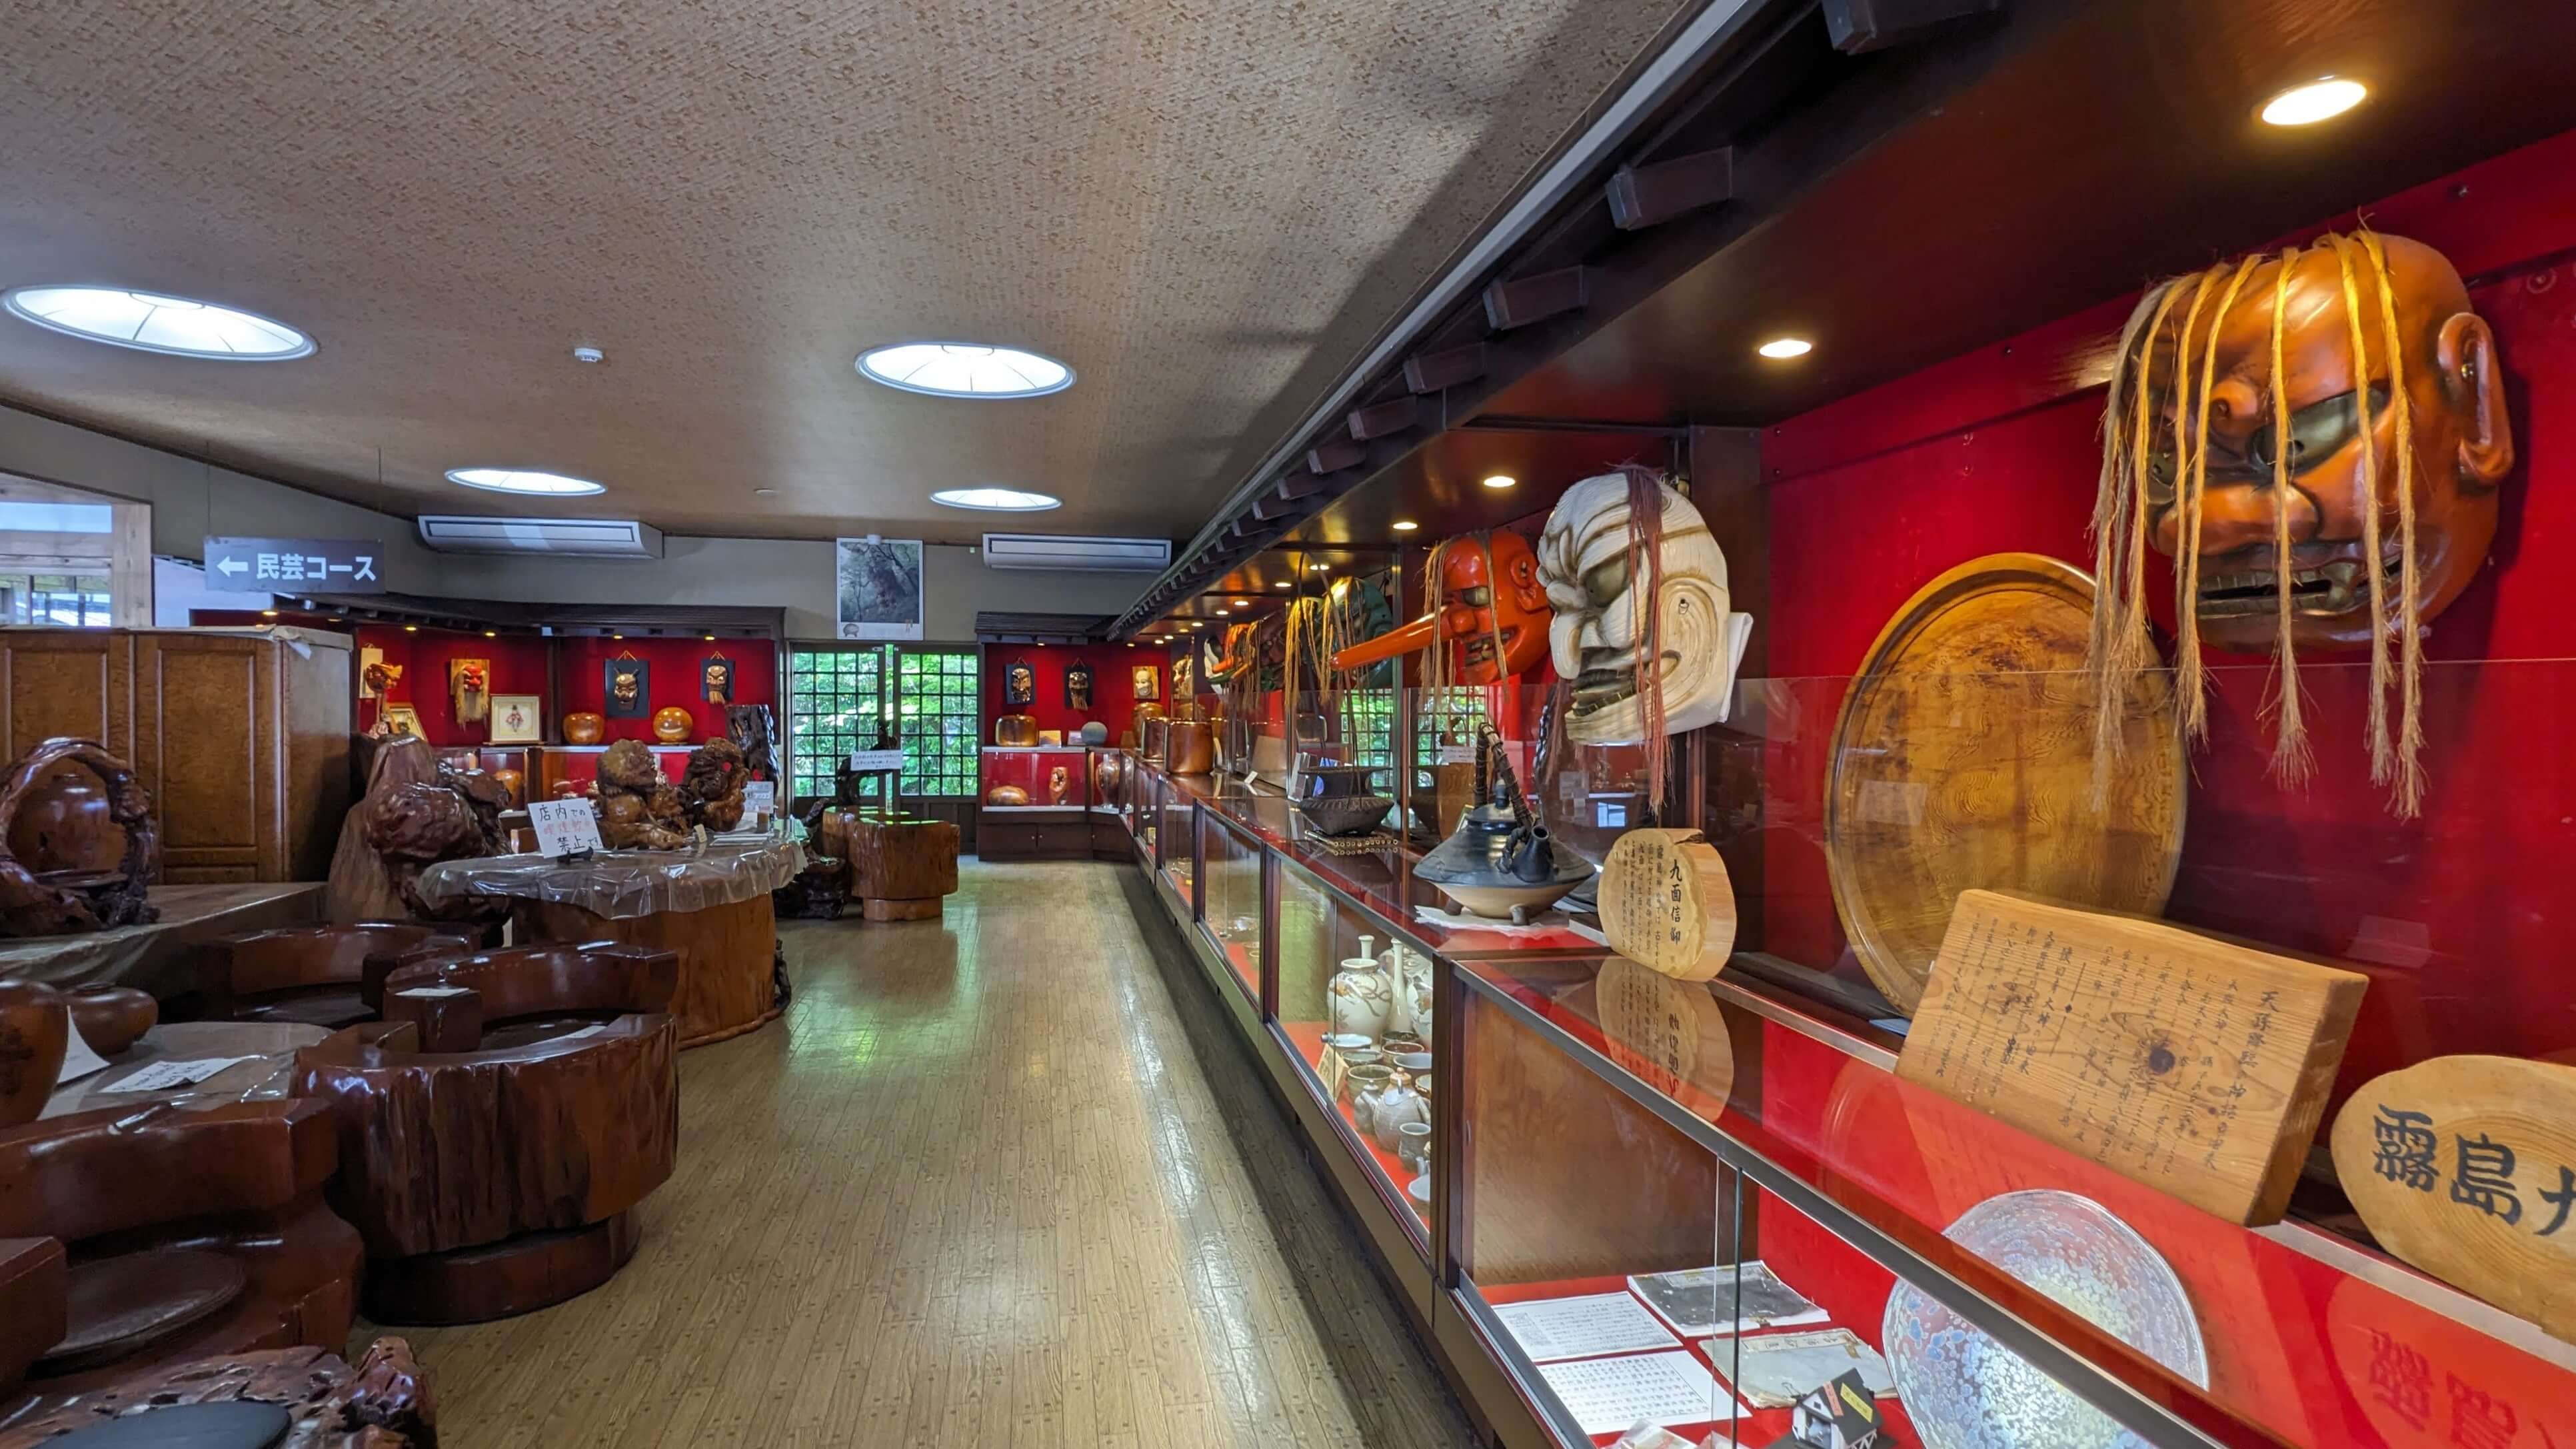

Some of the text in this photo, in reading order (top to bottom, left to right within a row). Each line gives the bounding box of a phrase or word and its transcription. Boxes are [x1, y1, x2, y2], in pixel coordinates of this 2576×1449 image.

[257, 553, 377, 581] 民芸コース
[539, 802, 586, 821] 店内での
[1670, 858, 1682, 945] 九面信仰
